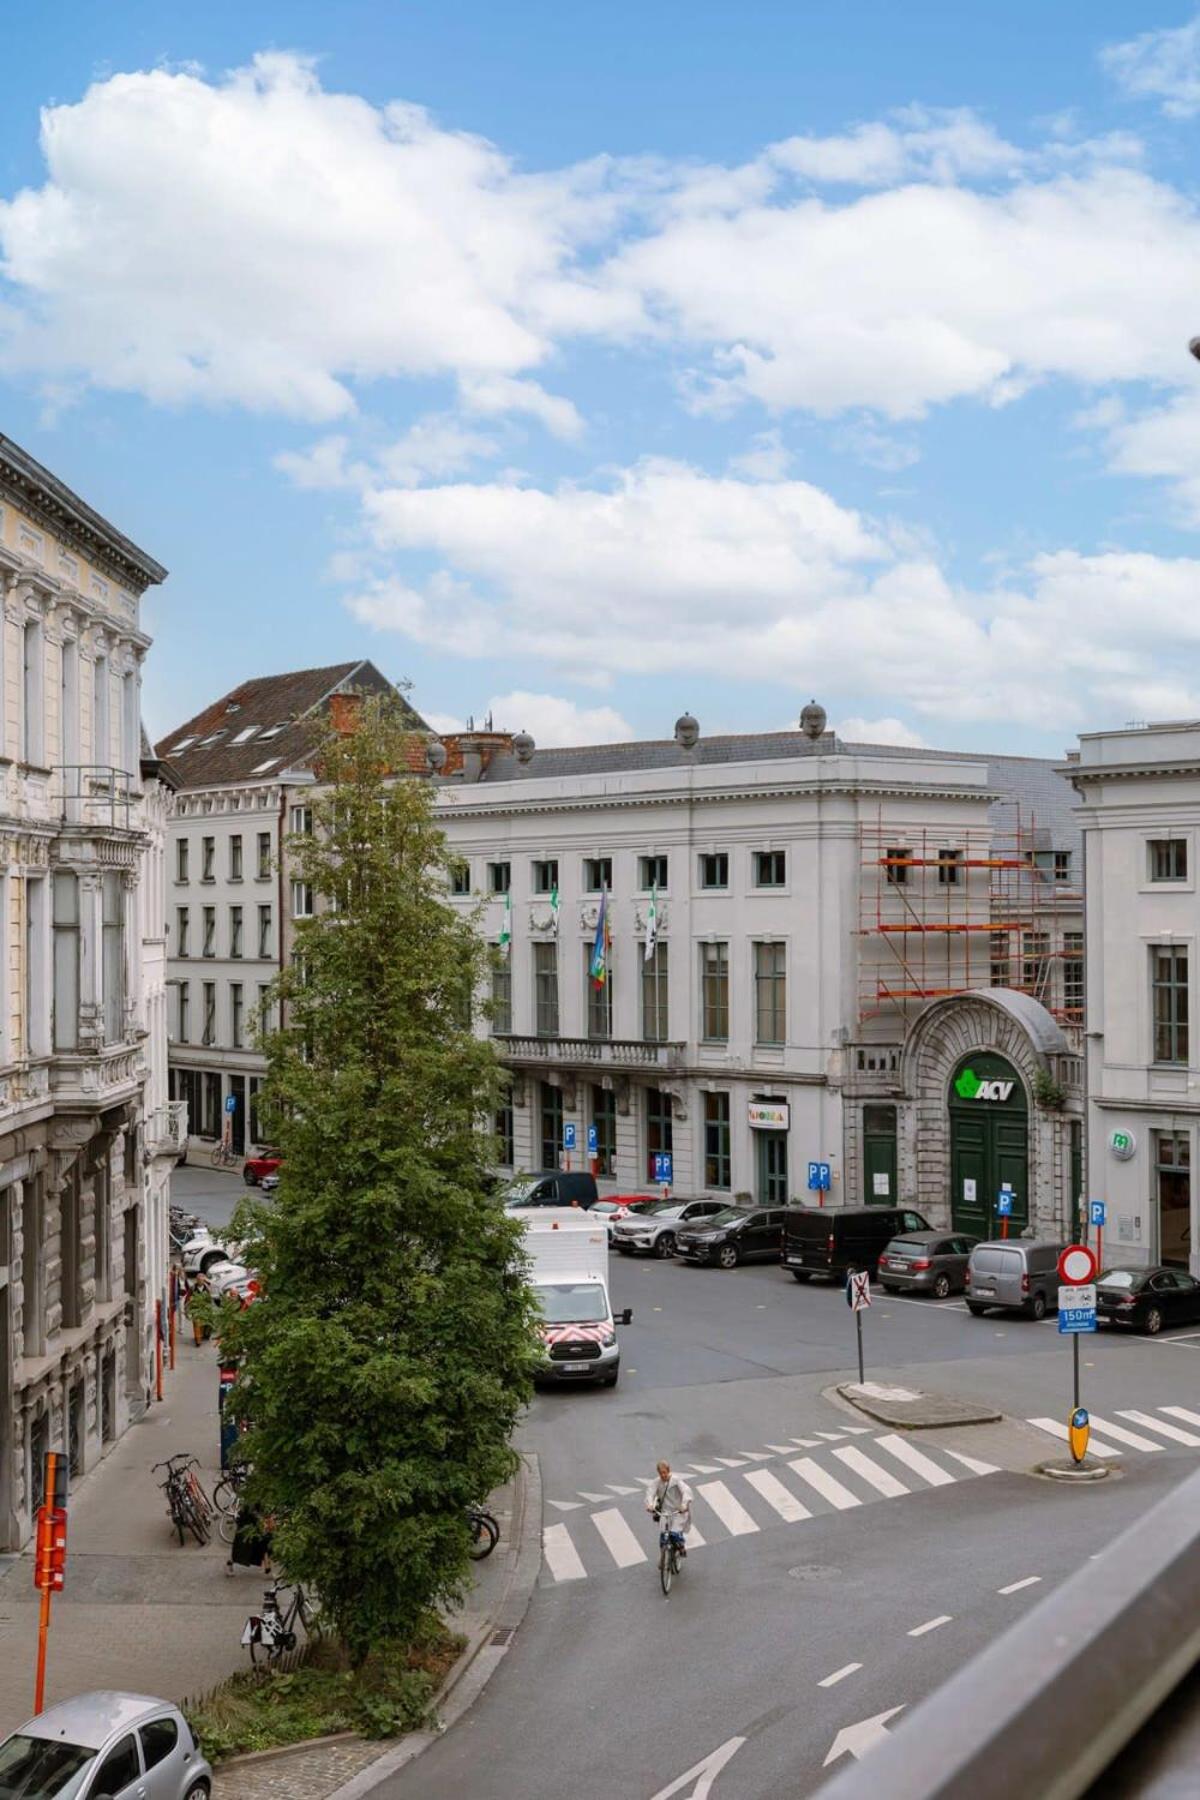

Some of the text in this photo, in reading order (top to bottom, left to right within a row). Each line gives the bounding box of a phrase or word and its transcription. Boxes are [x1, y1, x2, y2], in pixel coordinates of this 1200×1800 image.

[974, 1081, 1014, 1101] ACV
[566, 1127, 574, 1141] P
[589, 1129, 596, 1142] P
[656, 1158, 662, 1171] P
[663, 1158, 670, 1172] P
[810, 1164, 817, 1180] P
[820, 1165, 828, 1181] P
[1000, 1195, 1009, 1211] P
[1092, 1205, 1101, 1221] P
